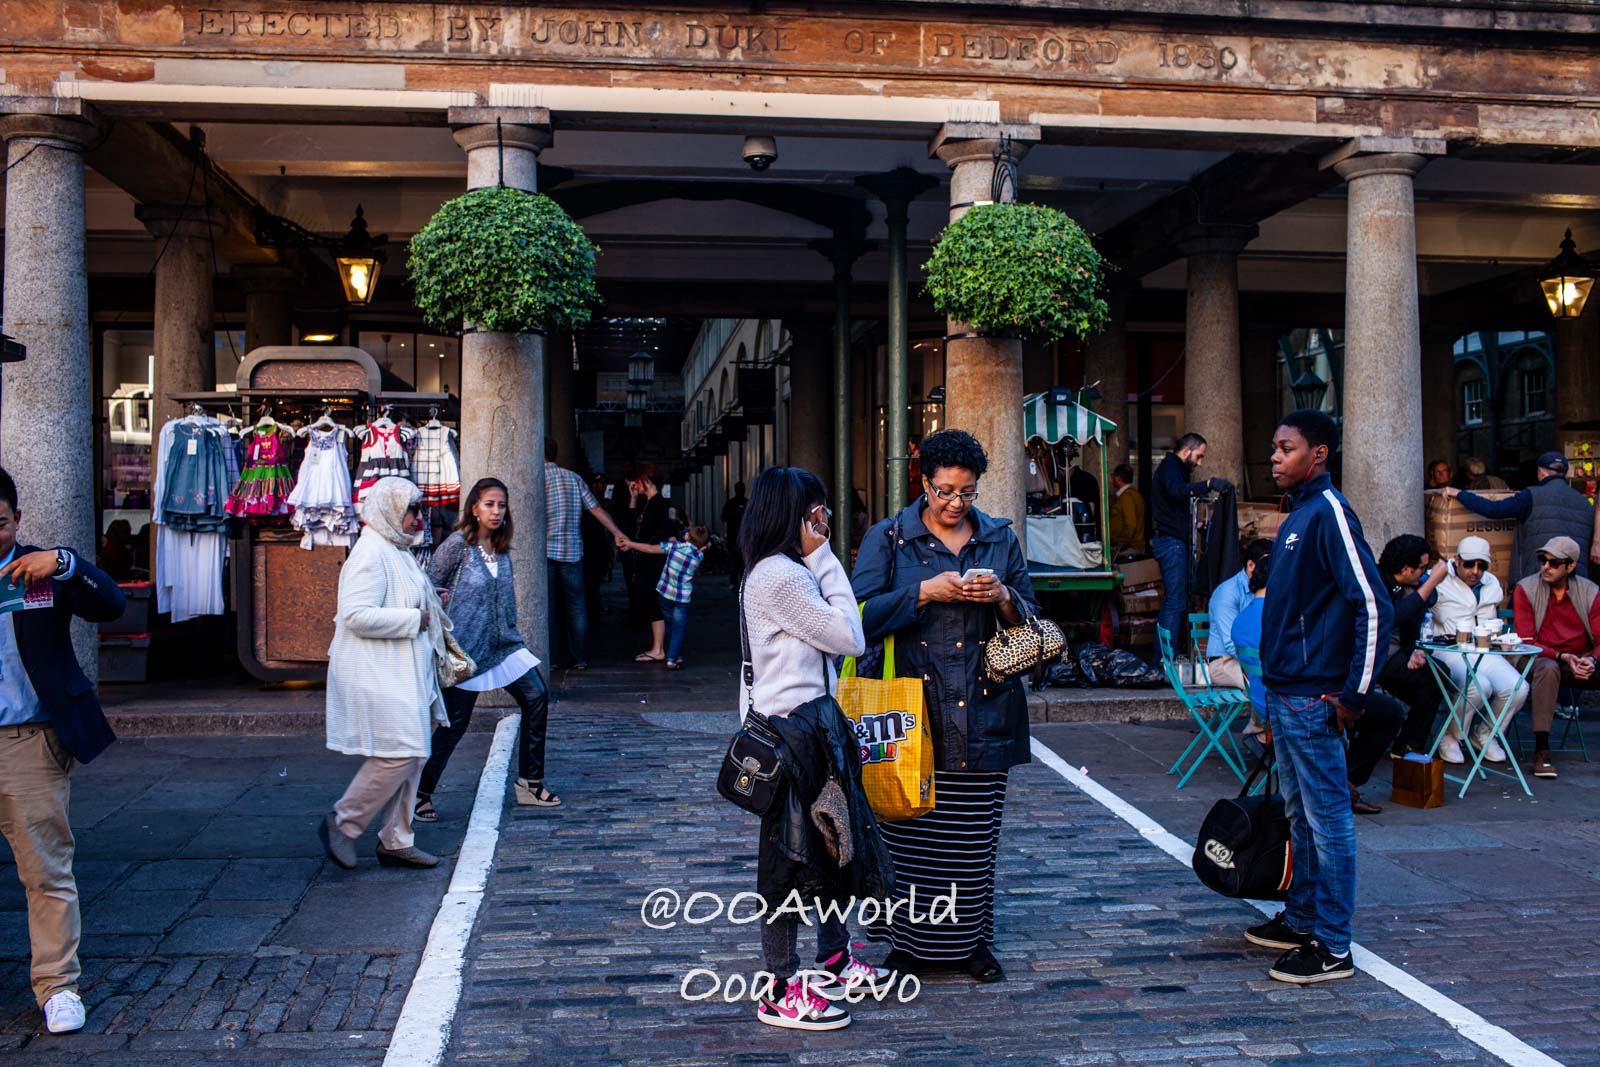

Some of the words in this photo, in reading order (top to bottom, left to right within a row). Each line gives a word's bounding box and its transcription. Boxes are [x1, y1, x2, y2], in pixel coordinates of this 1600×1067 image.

[197, 9, 401, 39] ERECTED
[446, 15, 503, 43] BY
[531, 18, 642, 48] JOHN
[685, 23, 797, 52] DUKE
[844, 29, 893, 56] OF
[933, 33, 1119, 65] BEDFORD
[1158, 42, 1238, 70] 1830
